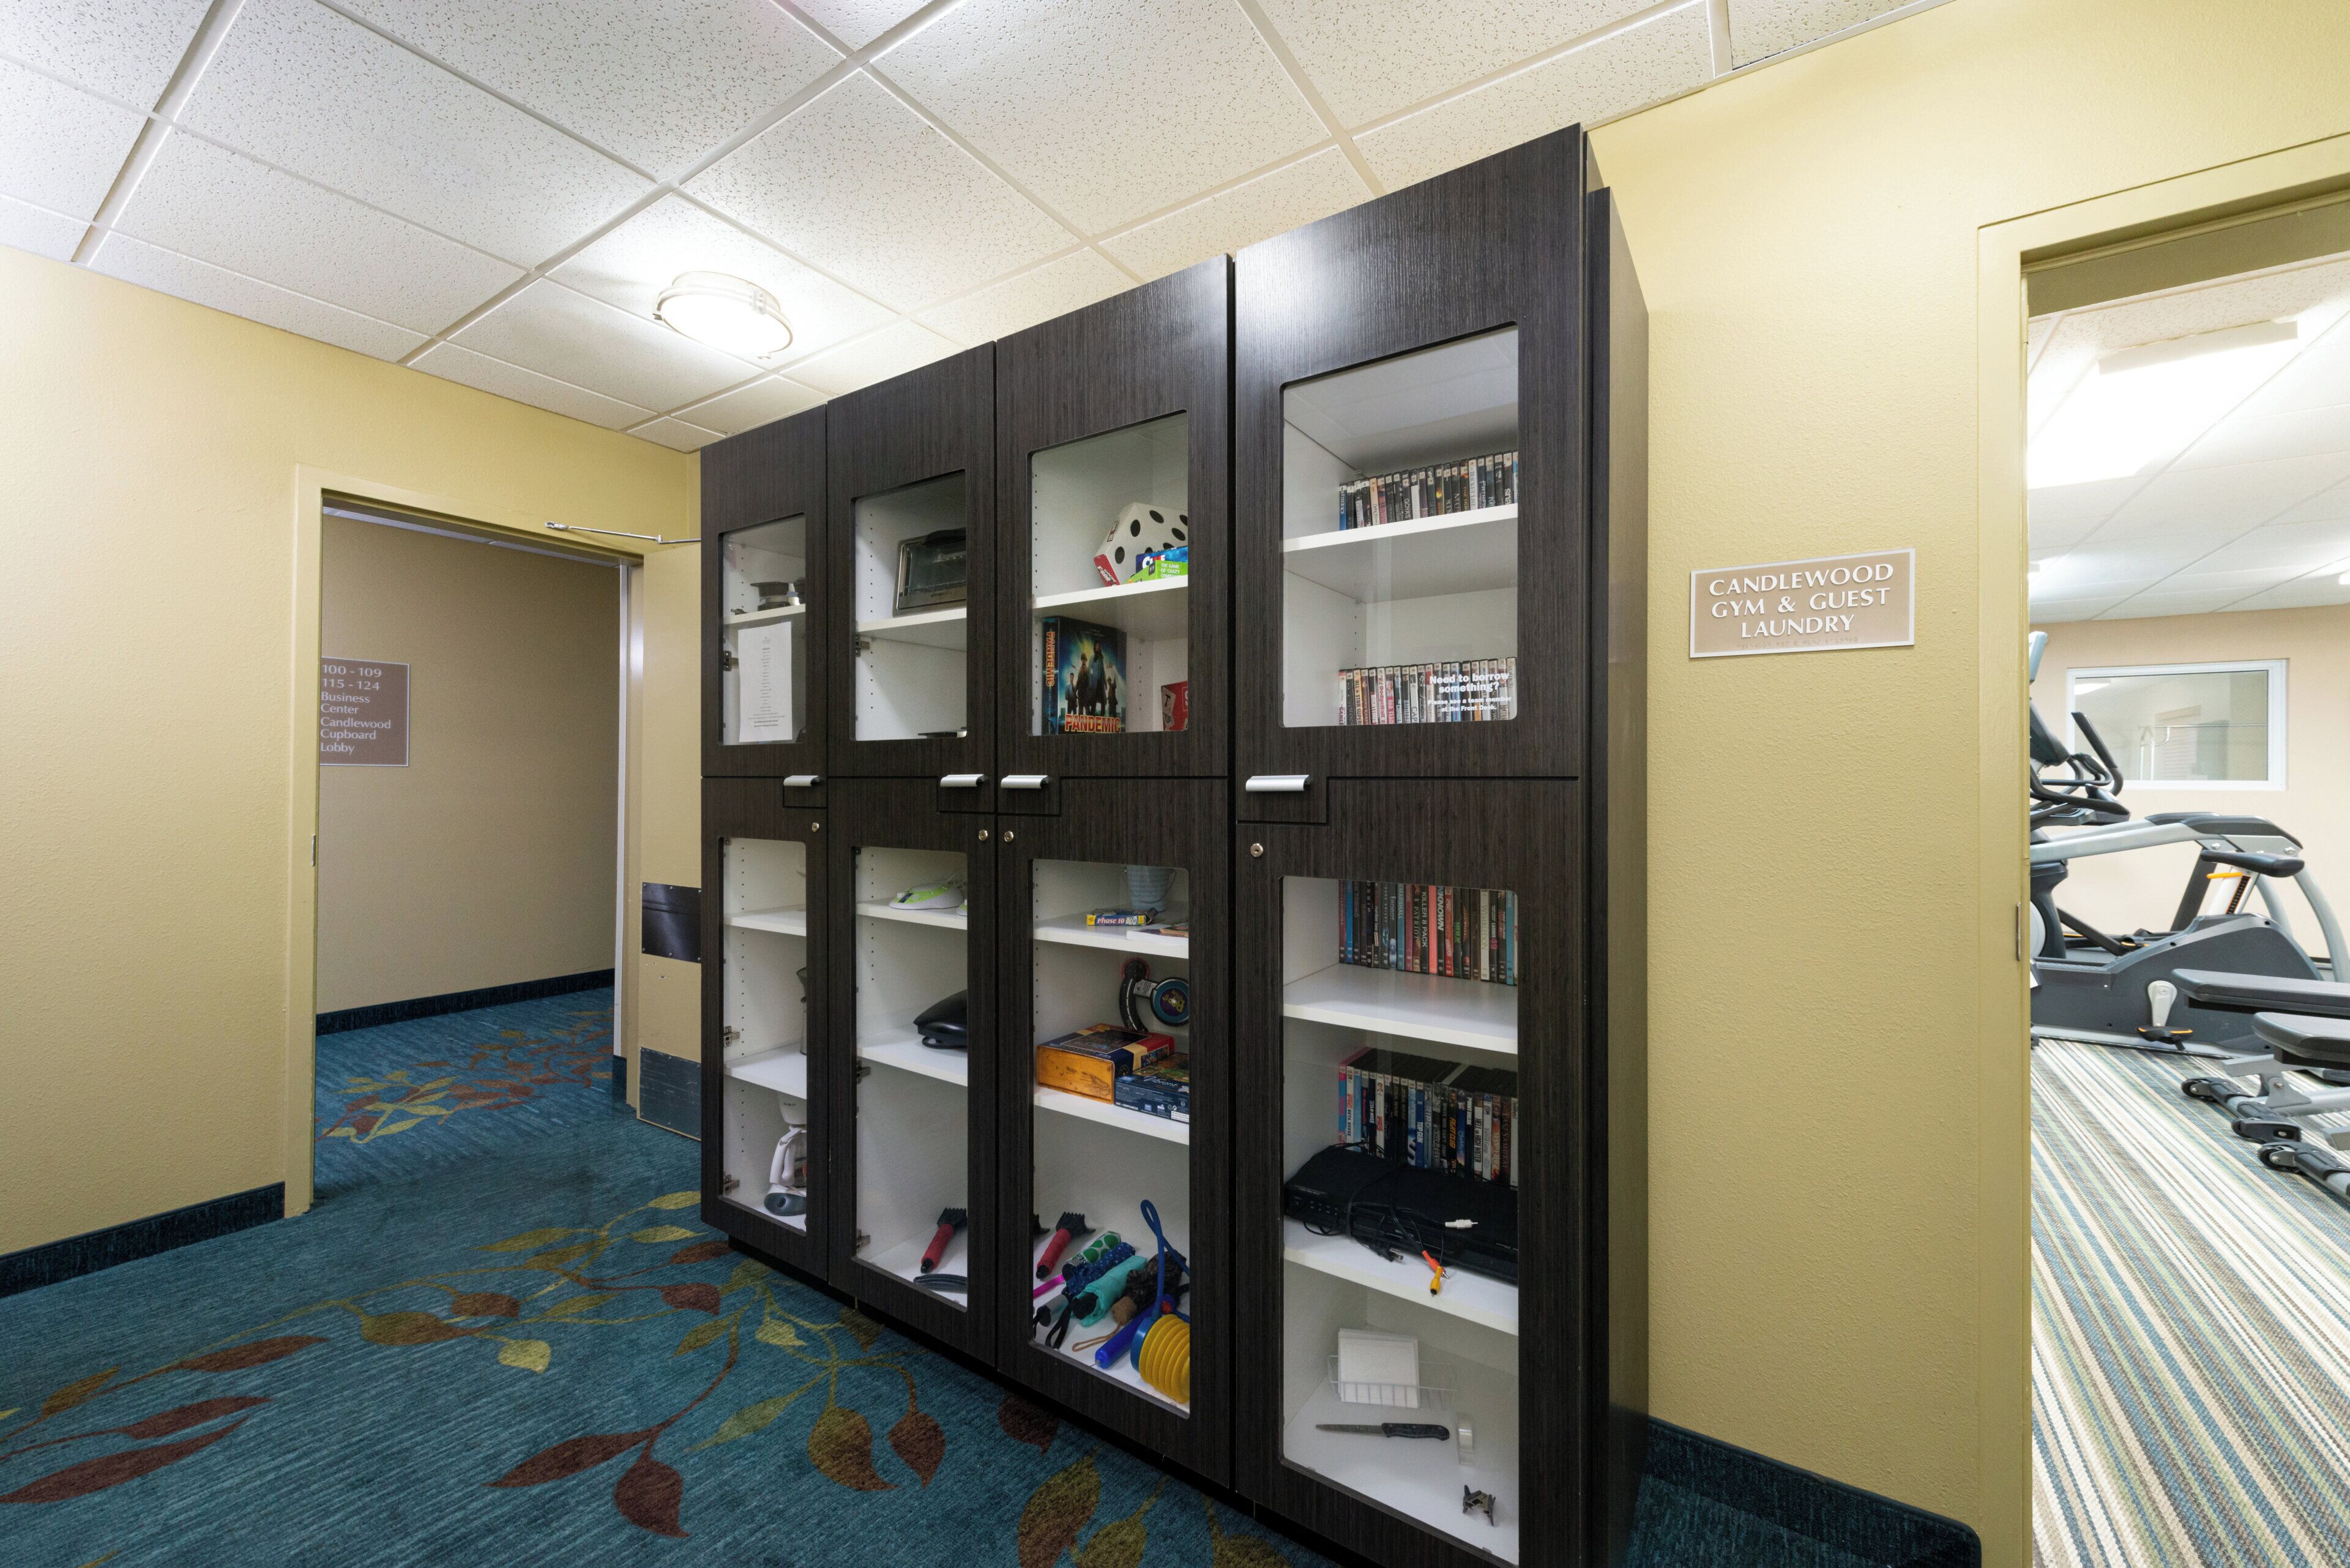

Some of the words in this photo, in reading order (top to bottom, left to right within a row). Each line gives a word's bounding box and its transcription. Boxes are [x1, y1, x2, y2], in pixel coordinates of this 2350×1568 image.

[1709, 563, 1894, 596] CANDLEWOOD
[1711, 599, 1765, 618] GYM
[1777, 596, 1796, 613] &
[1809, 588, 1891, 610] GUEST
[1741, 614, 1855, 638] LAUNDRY
[1045, 631, 1056, 687] PANDEMIC
[321, 665, 346, 675] 100
[359, 668, 382, 678] 109
[321, 678, 345, 688] 115
[357, 681, 380, 690] 124
[1430, 674, 1456, 684] Need
[1458, 674, 1469, 682] to
[1472, 673, 1510, 682] borrow
[1439, 681, 1499, 693] something?
[321, 691, 370, 703] Business
[320, 703, 359, 714] Center
[320, 717, 391, 729] Candlewood
[1064, 714, 1122, 733] PANDEMIC
[320, 729, 376, 741] Cupboard
[320, 742, 355, 755] Lobby
